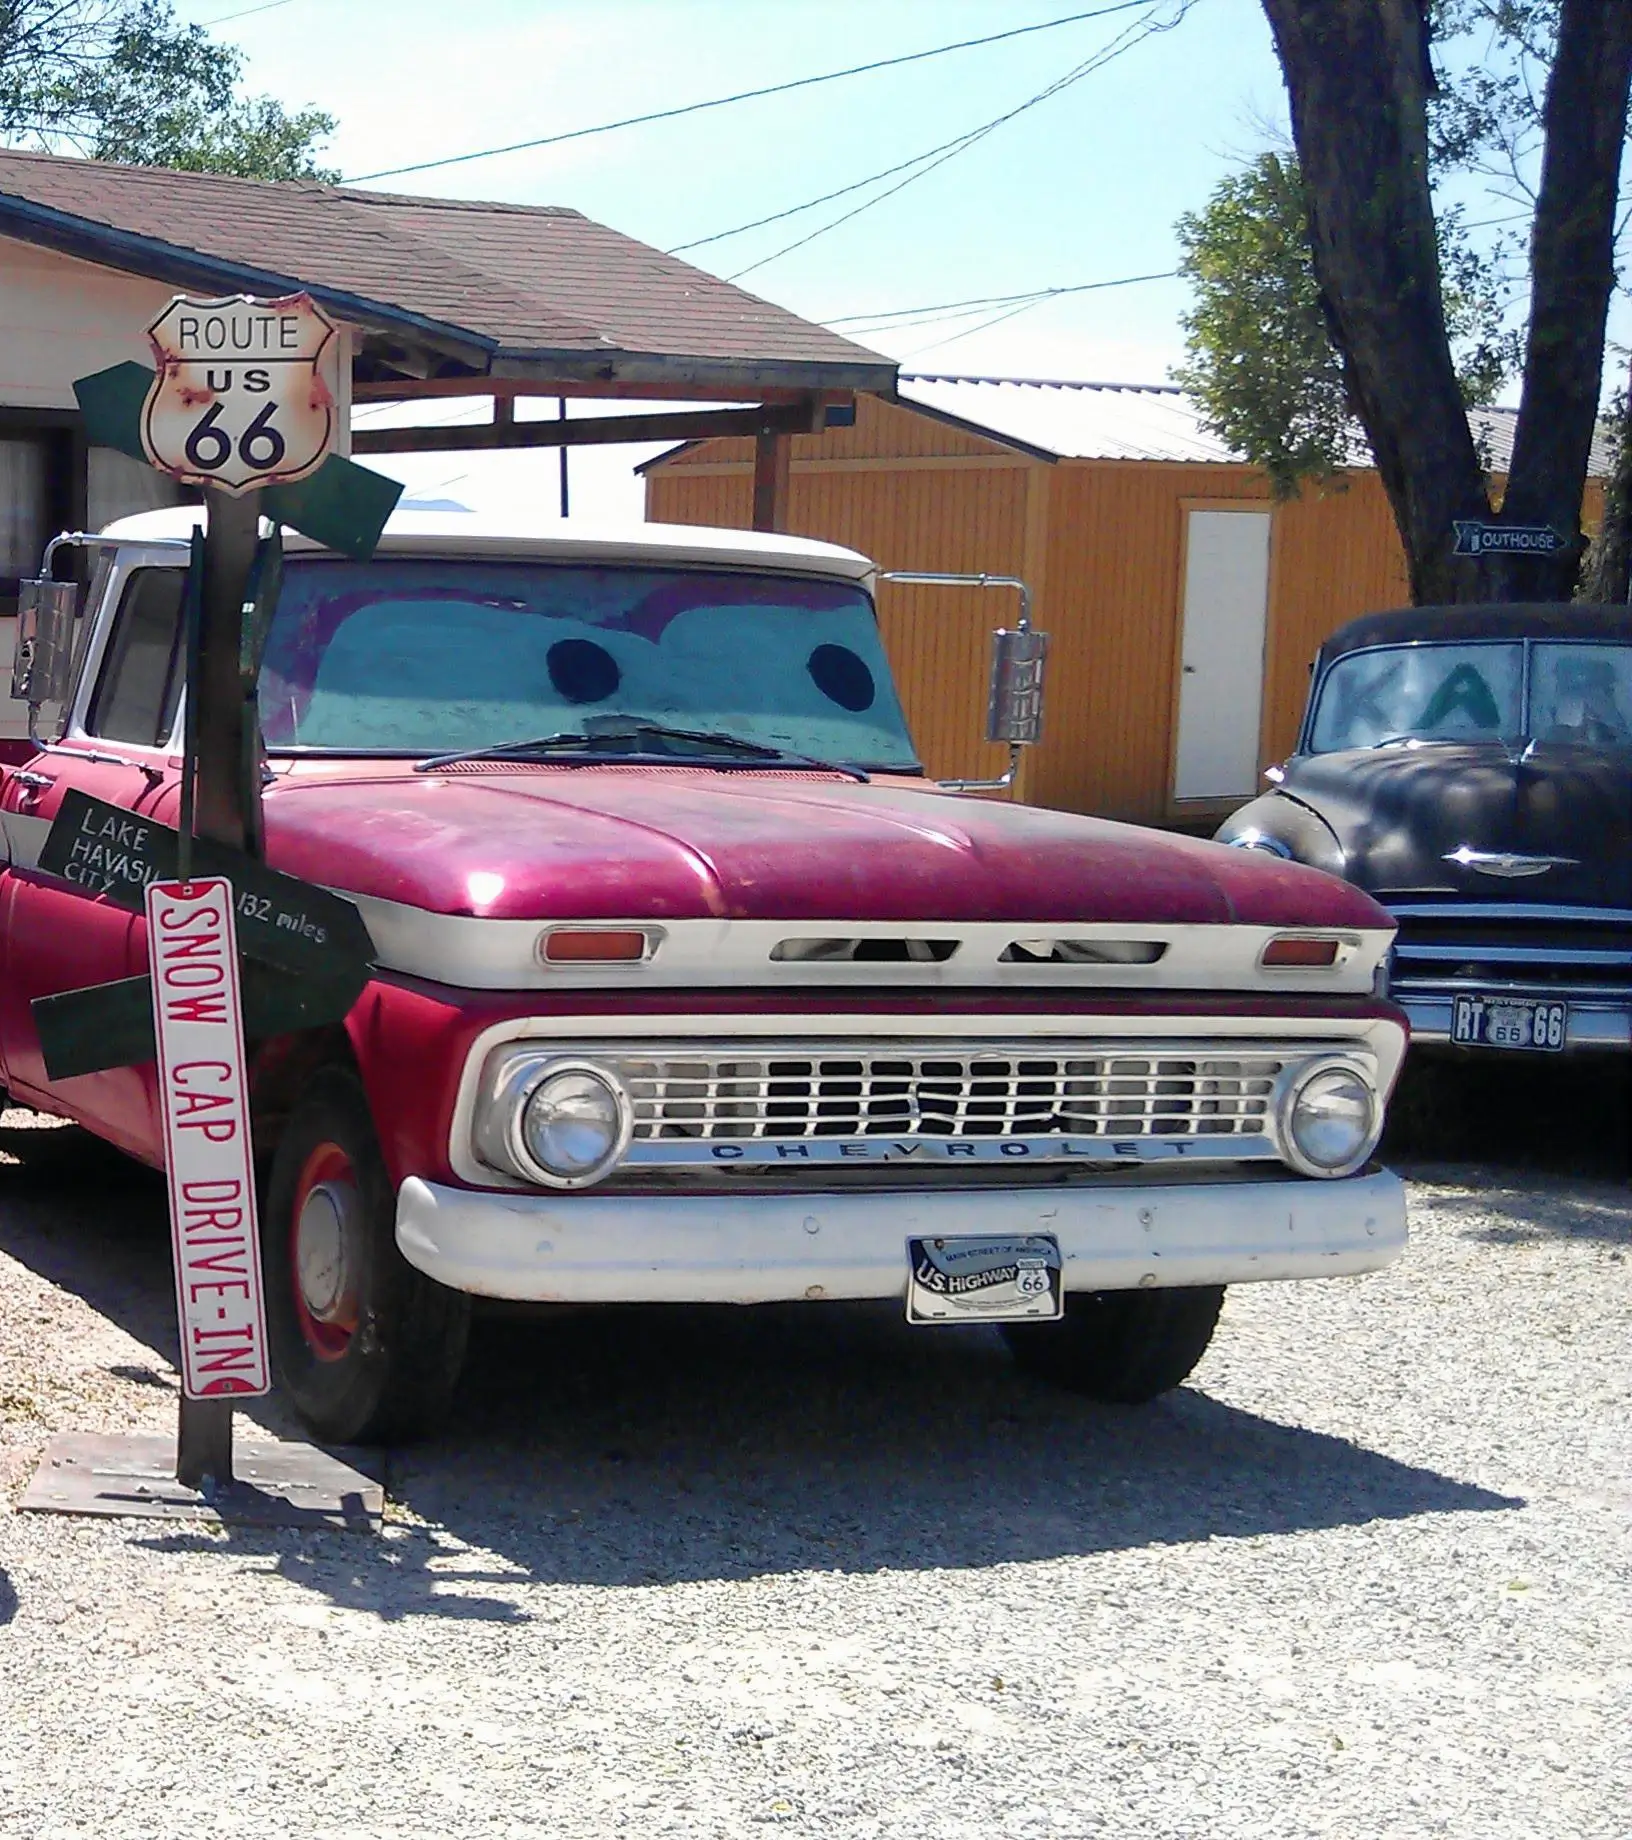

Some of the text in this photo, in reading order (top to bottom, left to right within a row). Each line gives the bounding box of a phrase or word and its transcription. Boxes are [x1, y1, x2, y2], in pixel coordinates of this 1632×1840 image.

[179, 315, 299, 350] ROUTE
[206, 369, 271, 393] US
[185, 401, 285, 470] 66
[1482, 532, 1555, 549] OUTHOUSE
[80, 808, 149, 851] LAKE
[64, 862, 116, 892] CITY
[237, 891, 326, 943] 132 miles
[1456, 1002, 1484, 1039] RT
[1533, 1006, 1562, 1046] 66
[1496, 1027, 1520, 1041] 66
[160, 907, 256, 1373] SNOW CAP DRIVE-IN
[712, 1140, 1194, 1160] CHEVROLET
[916, 1260, 1016, 1292] U.S. HIGHWAY
[1022, 1277, 1043, 1291] 66
